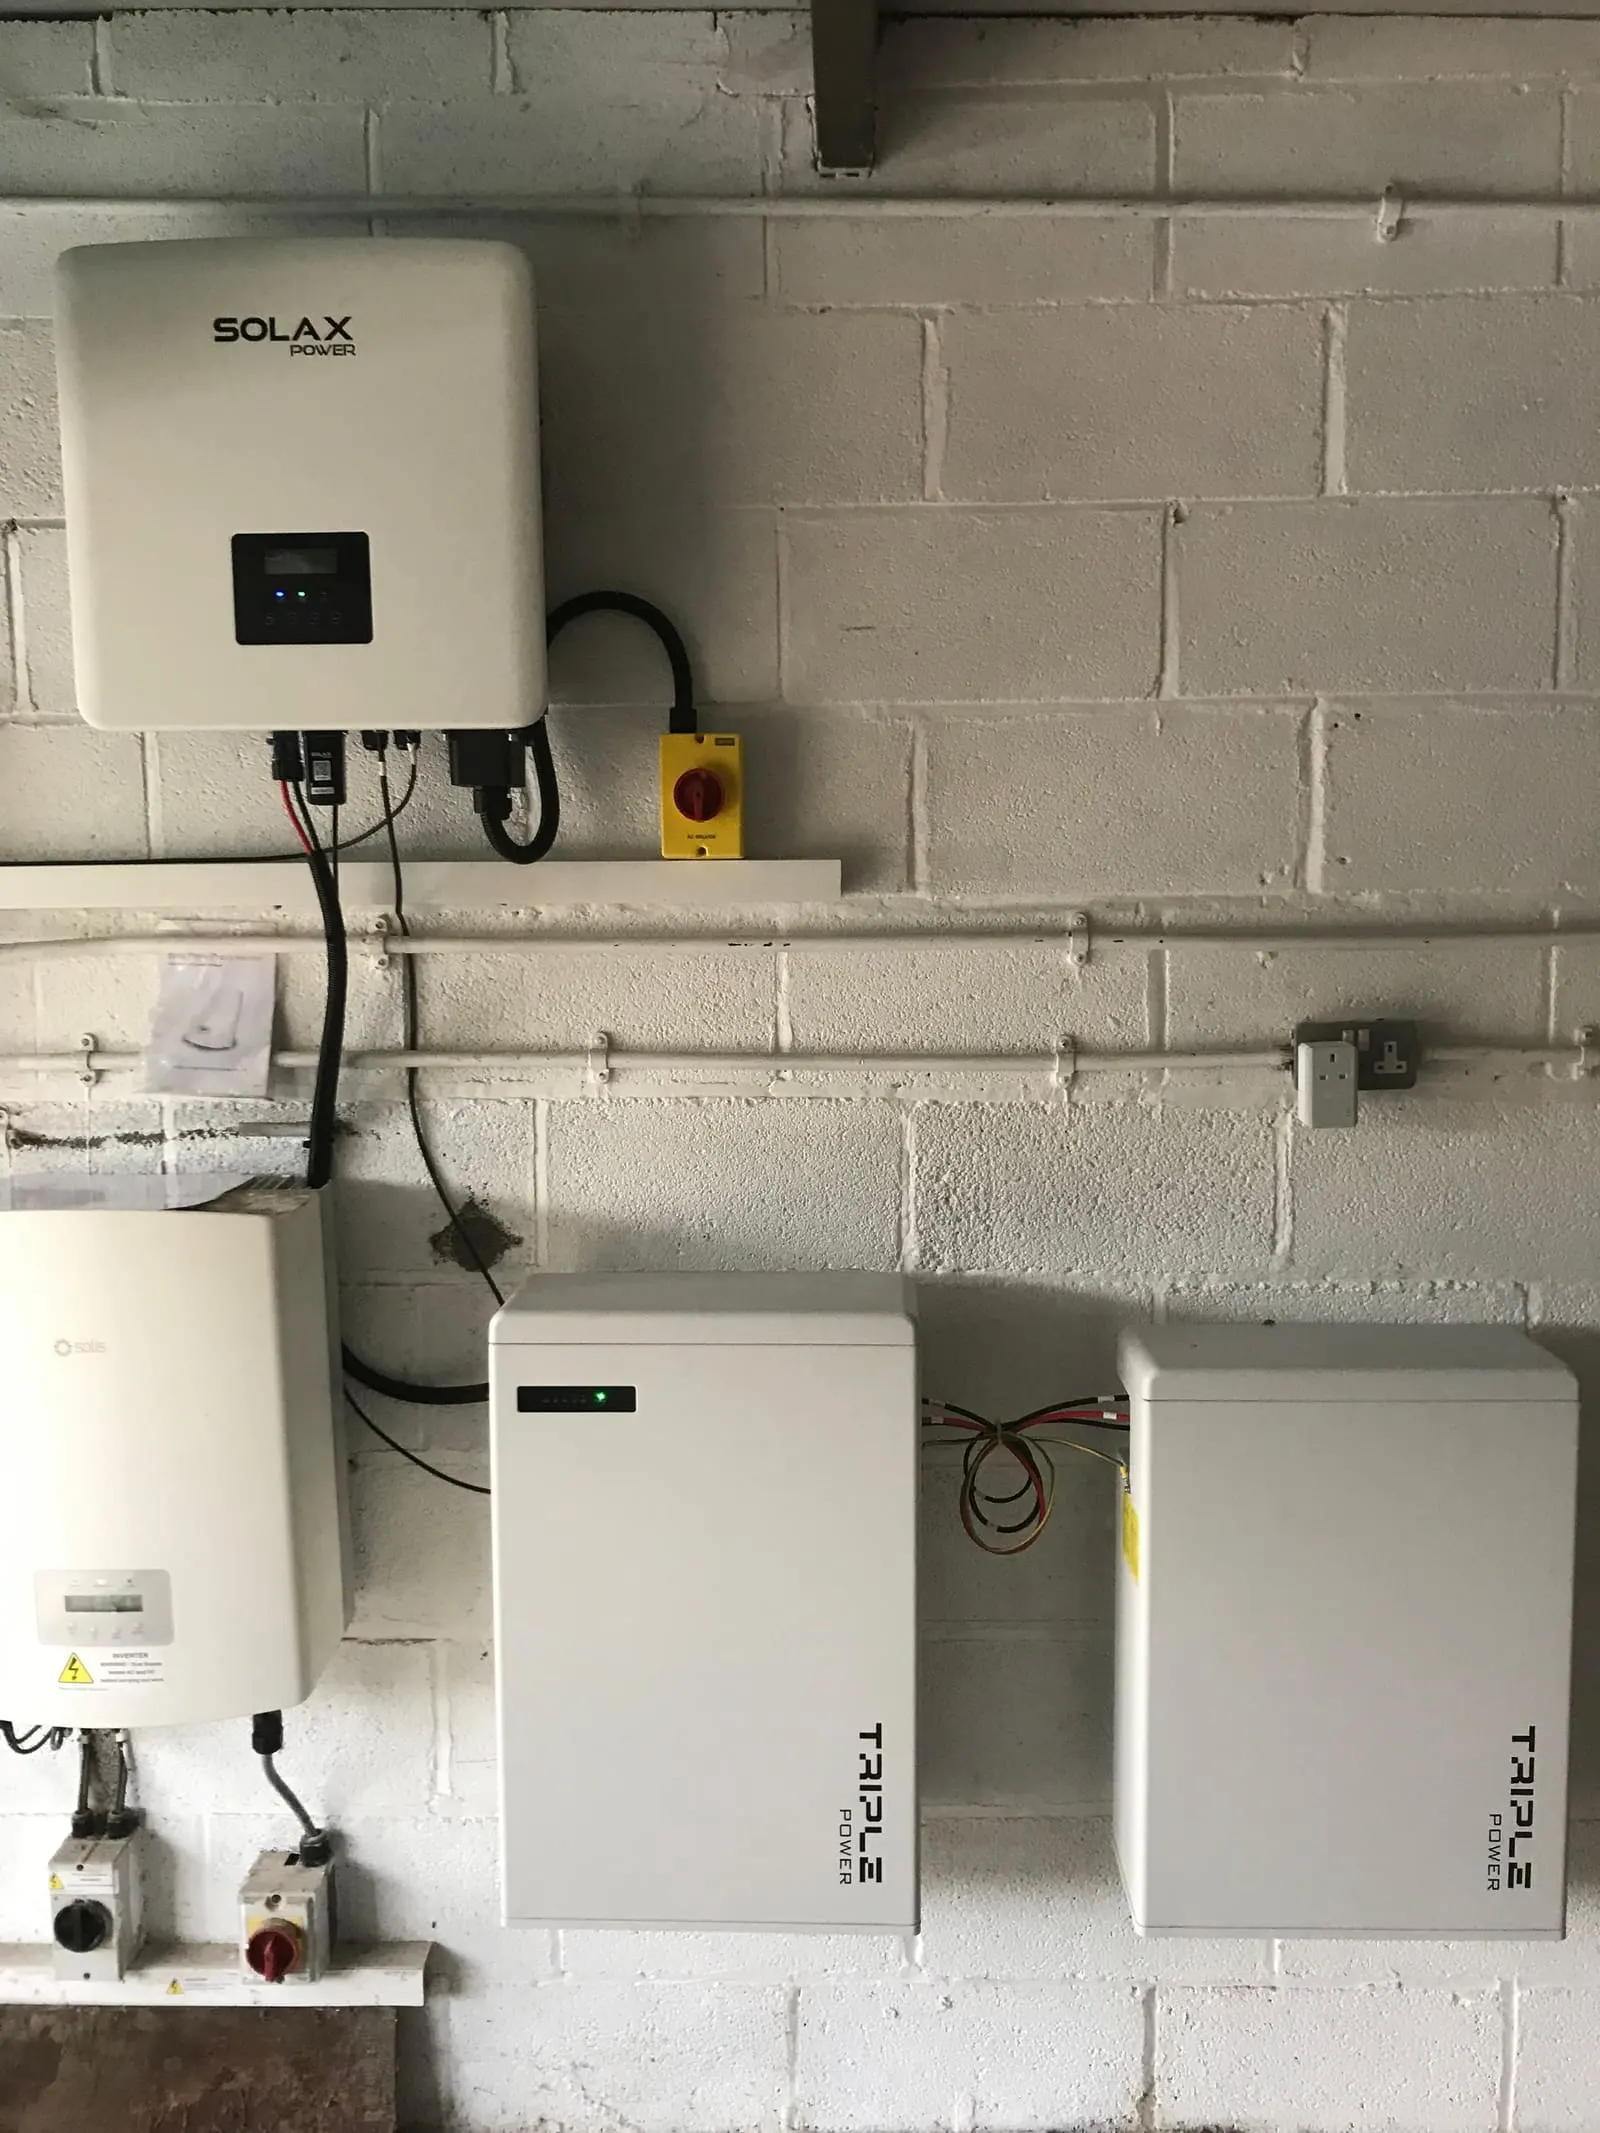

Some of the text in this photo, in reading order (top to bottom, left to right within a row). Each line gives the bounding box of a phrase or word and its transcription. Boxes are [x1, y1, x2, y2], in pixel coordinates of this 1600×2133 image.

[213, 316, 354, 342] SOLAX
[290, 344, 356, 356] POWER
[859, 1722, 882, 1883] TRIPLE
[1507, 1725, 1536, 1889] TRIPLE
[839, 1809, 852, 1885] POWER
[1487, 1813, 1502, 1891] POWER
